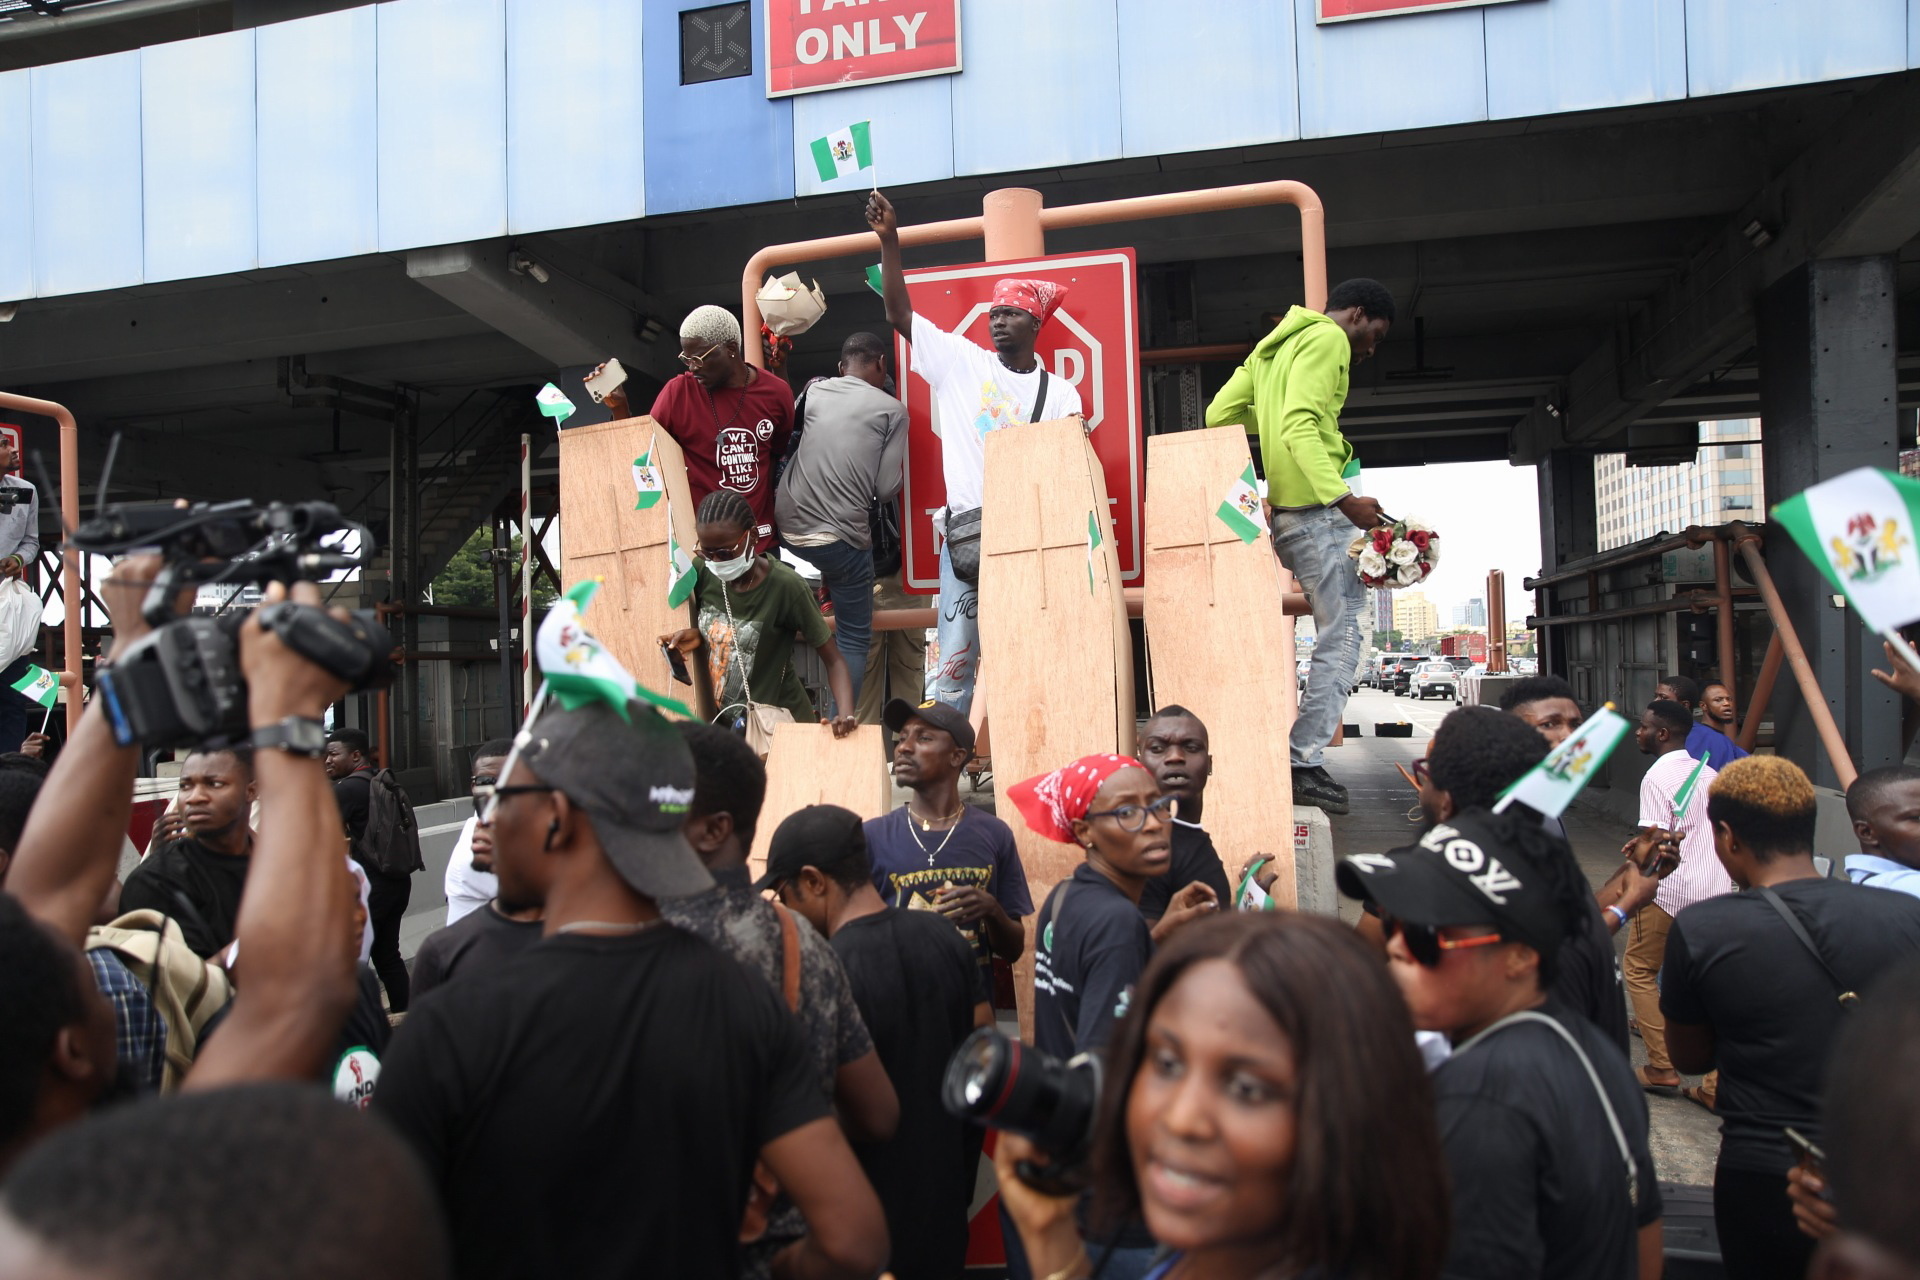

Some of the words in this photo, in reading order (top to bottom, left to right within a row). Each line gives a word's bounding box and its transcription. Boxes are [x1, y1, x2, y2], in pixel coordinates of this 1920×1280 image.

[796, 12, 927, 65] ONLY
[727, 432, 747, 443] WE
[721, 443, 755, 455] CAN'T
[720, 452, 756, 466] CONTINUE
[728, 462, 753, 475] LIKE
